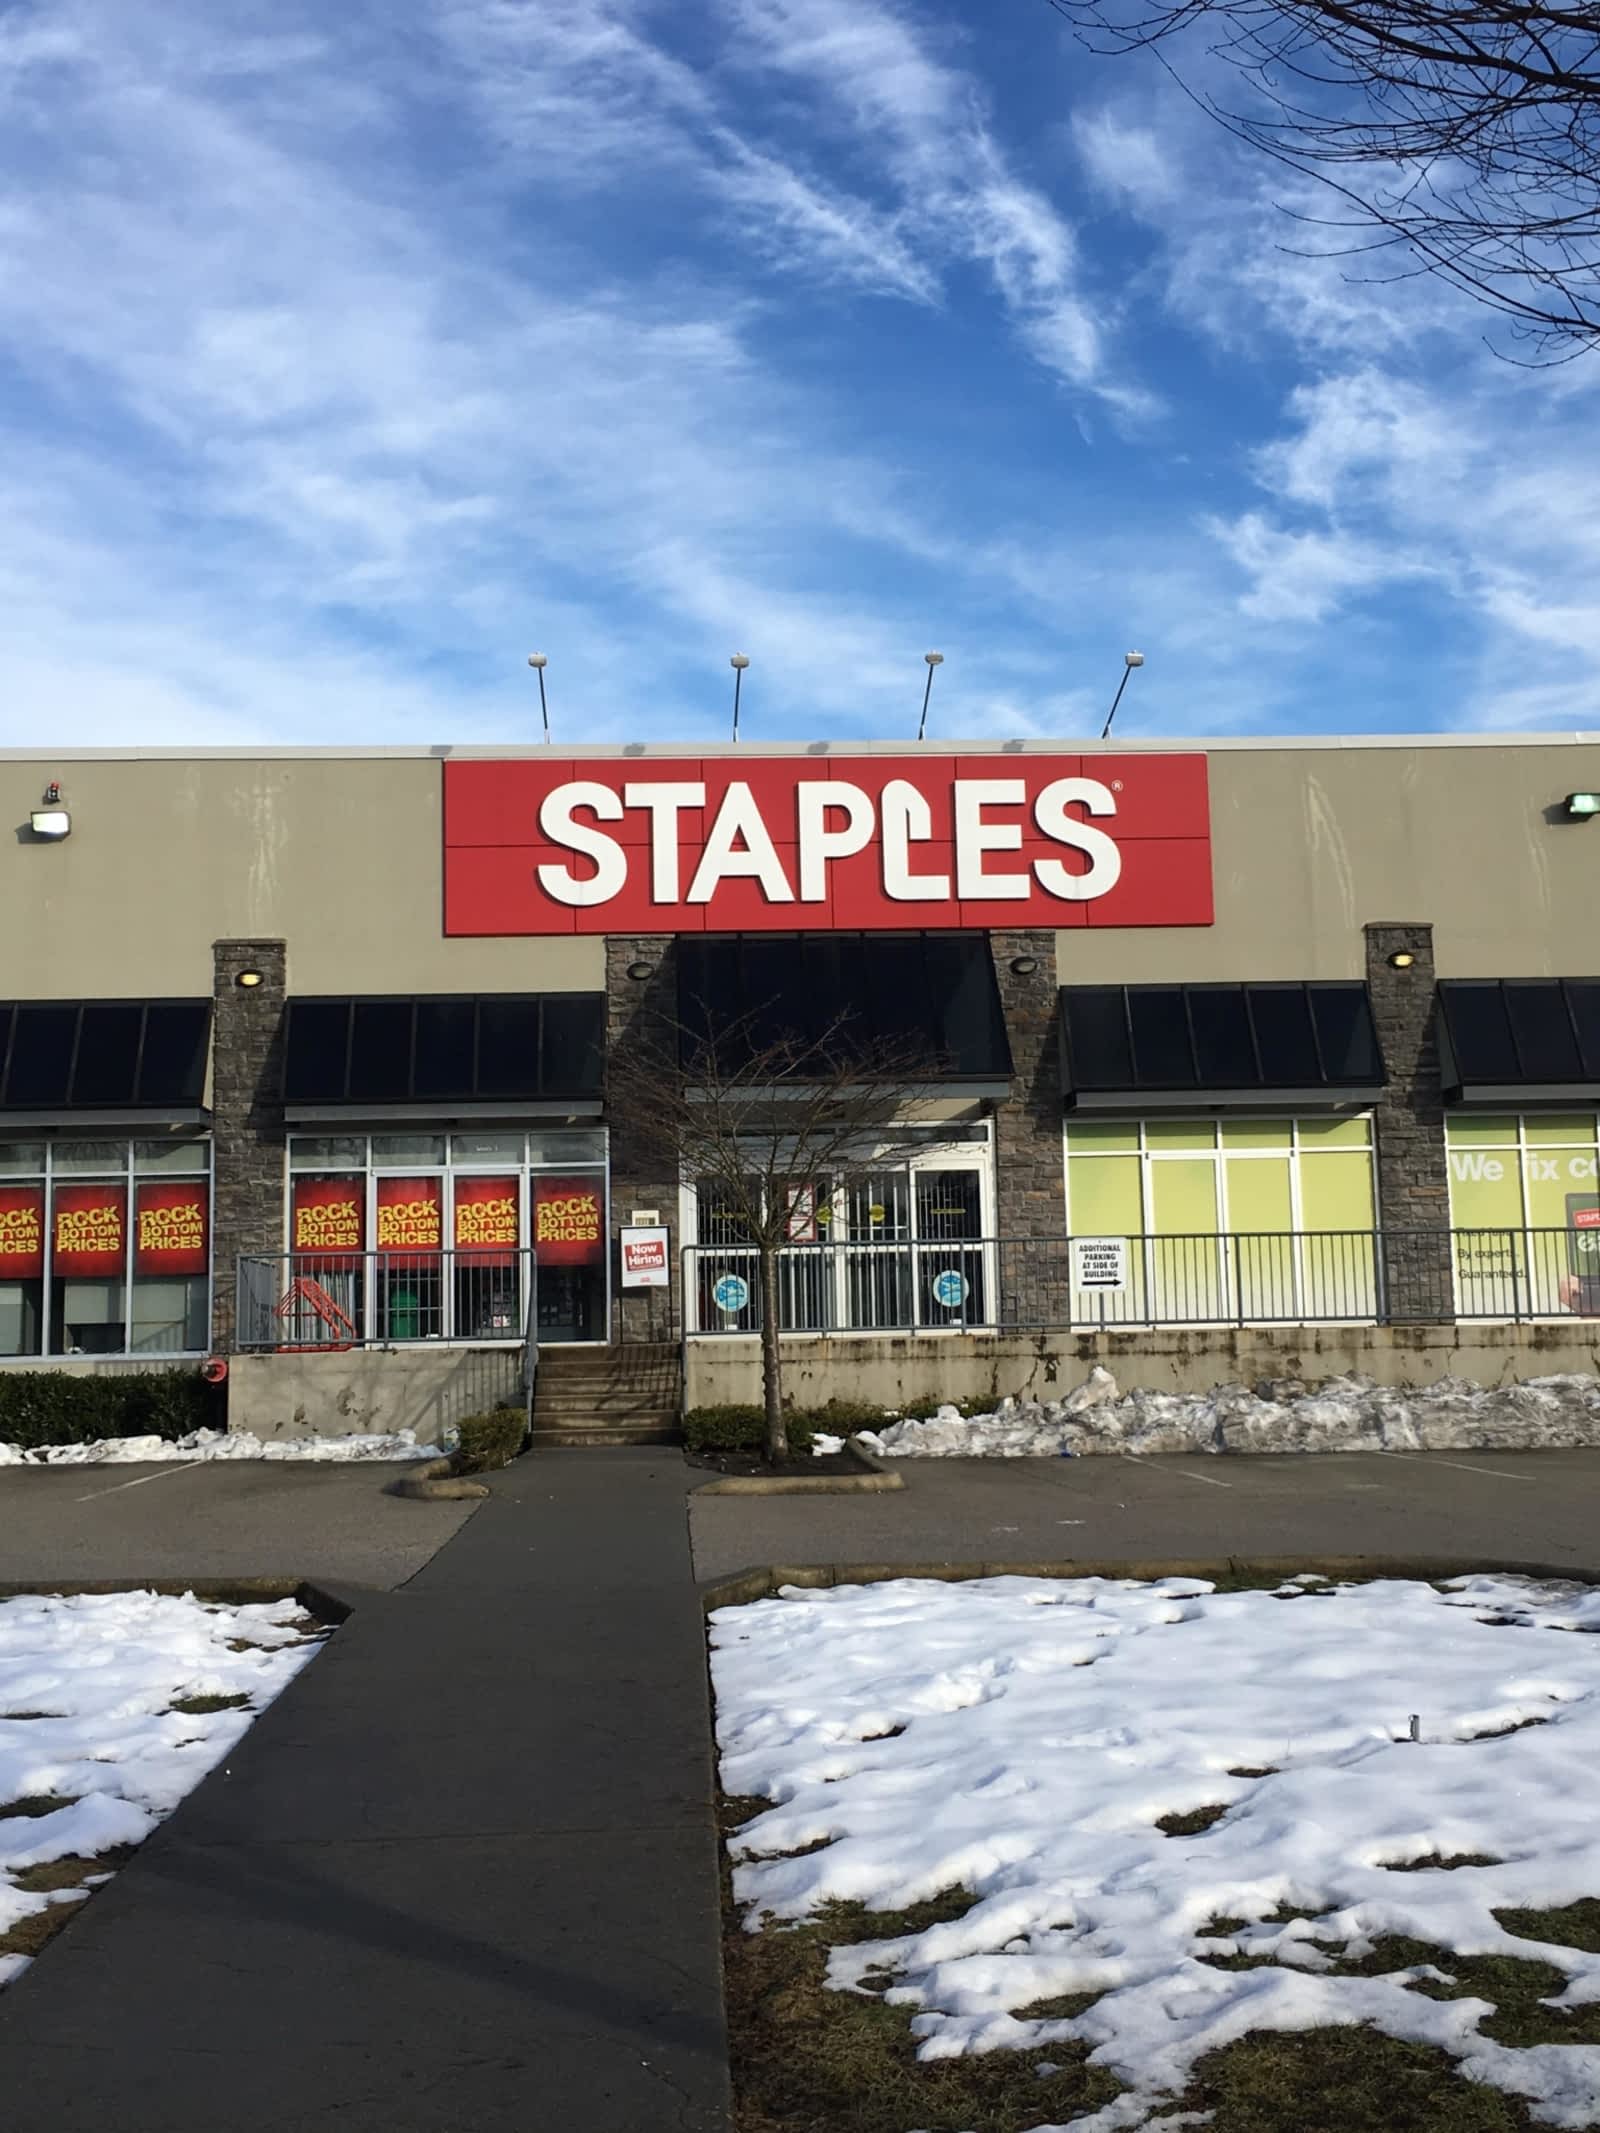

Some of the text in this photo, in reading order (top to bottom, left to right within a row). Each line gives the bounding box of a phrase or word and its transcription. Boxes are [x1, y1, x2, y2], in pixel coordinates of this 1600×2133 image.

[1450, 1153, 1504, 1181] We
[1522, 1152, 1560, 1181] ix
[296, 1201, 358, 1223] ROCK
[378, 1199, 439, 1222] ROCK
[456, 1198, 516, 1221] ROCK
[537, 1196, 597, 1218] ROCK
[57, 1206, 120, 1229] ROCK
[139, 1204, 202, 1227] ROCK
[539, 1214, 598, 1229] BOTTOM
[141, 1222, 203, 1237] BOTTOM
[298, 1219, 359, 1234] BOTTOM
[379, 1217, 439, 1233] BOTTOM
[458, 1216, 517, 1231] BOTTOM
[58, 1224, 120, 1239] BOTTOM
[378, 1231, 439, 1245] PRICES
[456, 1229, 517, 1243] PRICES
[537, 1227, 598, 1242] PRICES
[57, 1238, 120, 1252] PRICES
[140, 1235, 202, 1250] PRICES
[296, 1233, 359, 1247] PRICES
[631, 1245, 657, 1255] Now
[1079, 1244, 1120, 1252] ADDITIONAL
[628, 1254, 663, 1266] Hiring
[1082, 1261, 1118, 1269] AT SIDE OF
[1084, 1270, 1118, 1278] BUILDING
